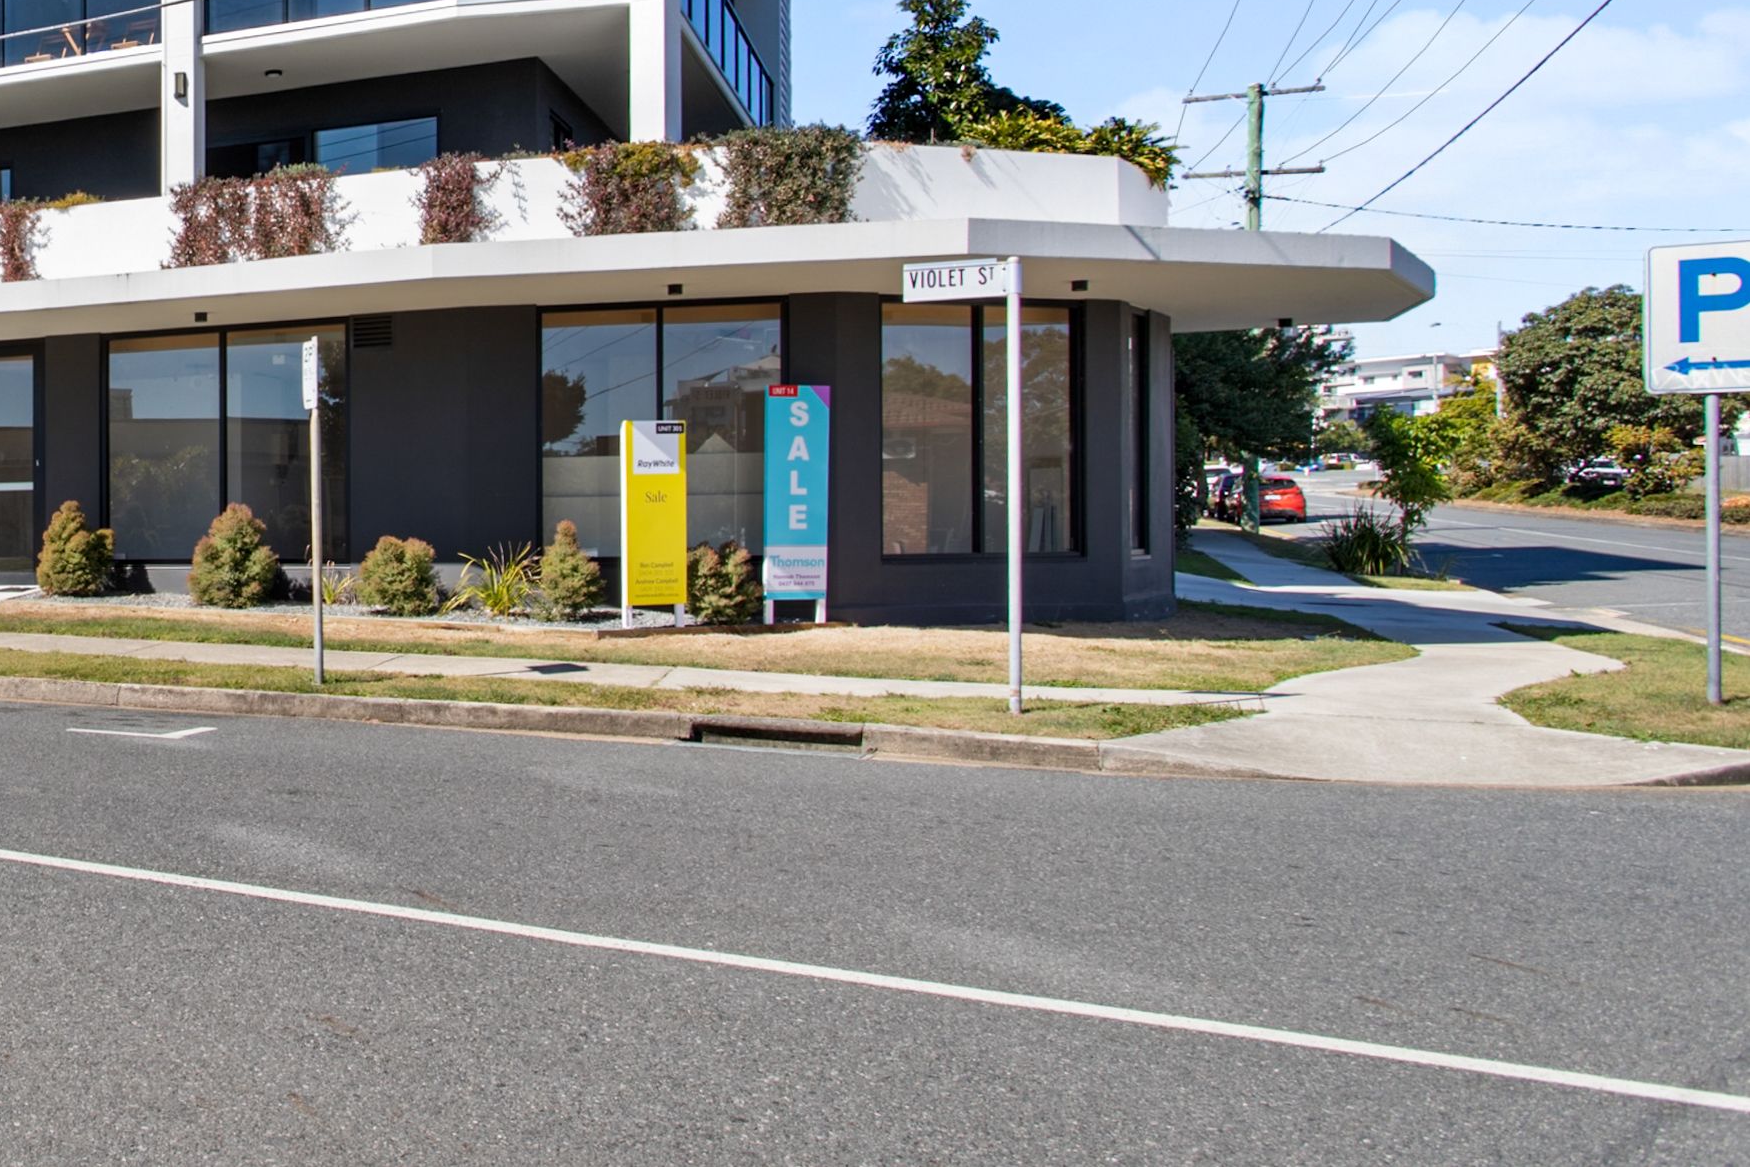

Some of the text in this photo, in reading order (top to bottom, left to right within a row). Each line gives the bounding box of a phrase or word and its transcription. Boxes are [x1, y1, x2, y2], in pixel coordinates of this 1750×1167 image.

[910, 268, 965, 289] VIOLET
[1679, 257, 1750, 344] P
[787, 401, 810, 530] SALE
[645, 490, 668, 503] Sale
[769, 555, 825, 567] Thomson
